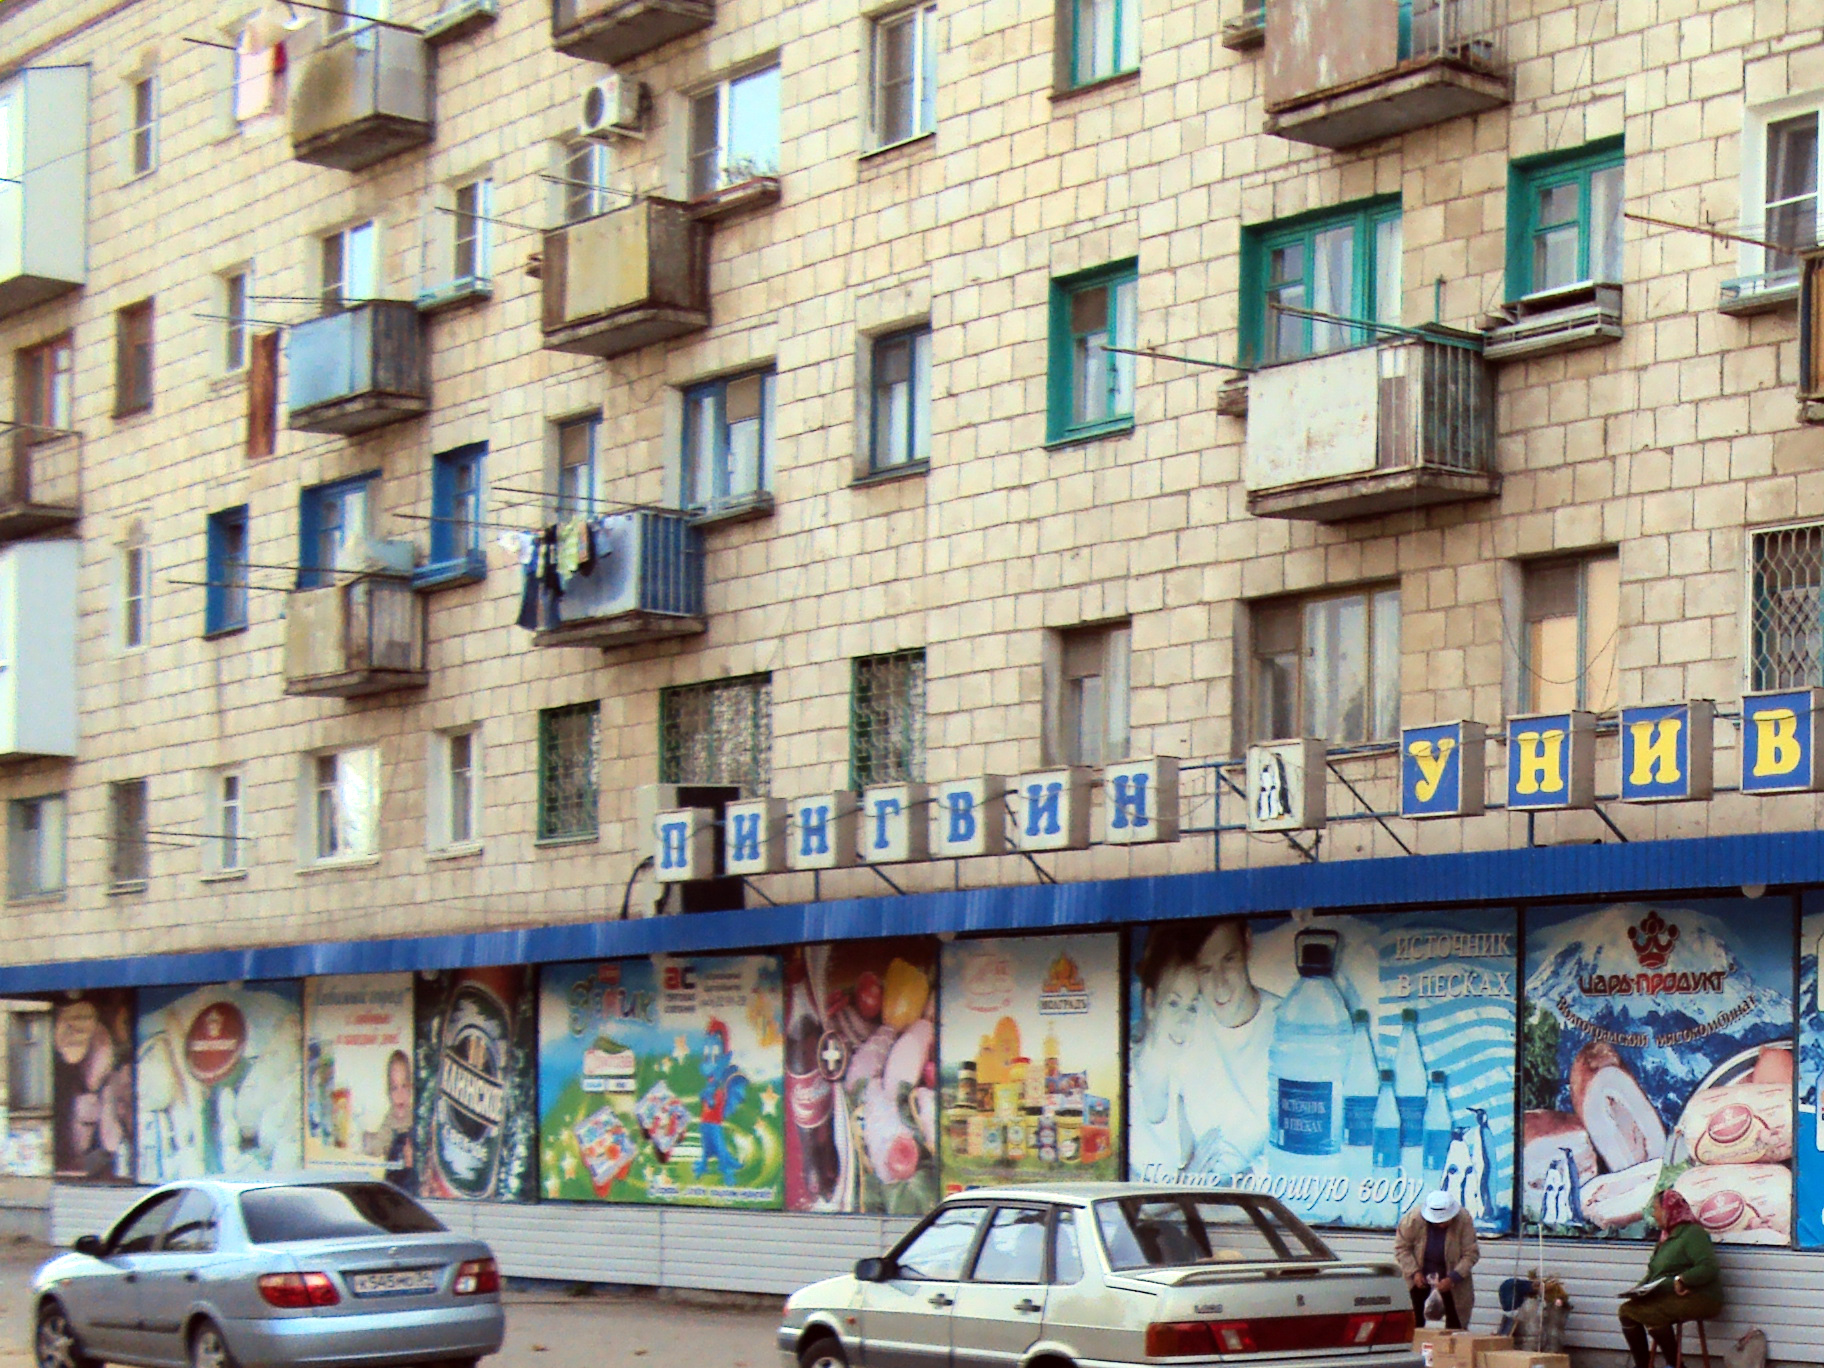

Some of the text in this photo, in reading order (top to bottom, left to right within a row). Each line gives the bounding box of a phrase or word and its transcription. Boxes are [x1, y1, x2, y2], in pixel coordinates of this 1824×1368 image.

[659, 771, 1151, 870] ПИНГВИН
[1395, 932, 1516, 962] ИСТОЧНИК
[1397, 971, 1513, 999] В ПЕСКАХ
[1556, 995, 1757, 1049] Волгоградский мясокомбинат
[1228, 1171, 1350, 1211] хорошую
[1358, 1165, 1426, 1213] воду
